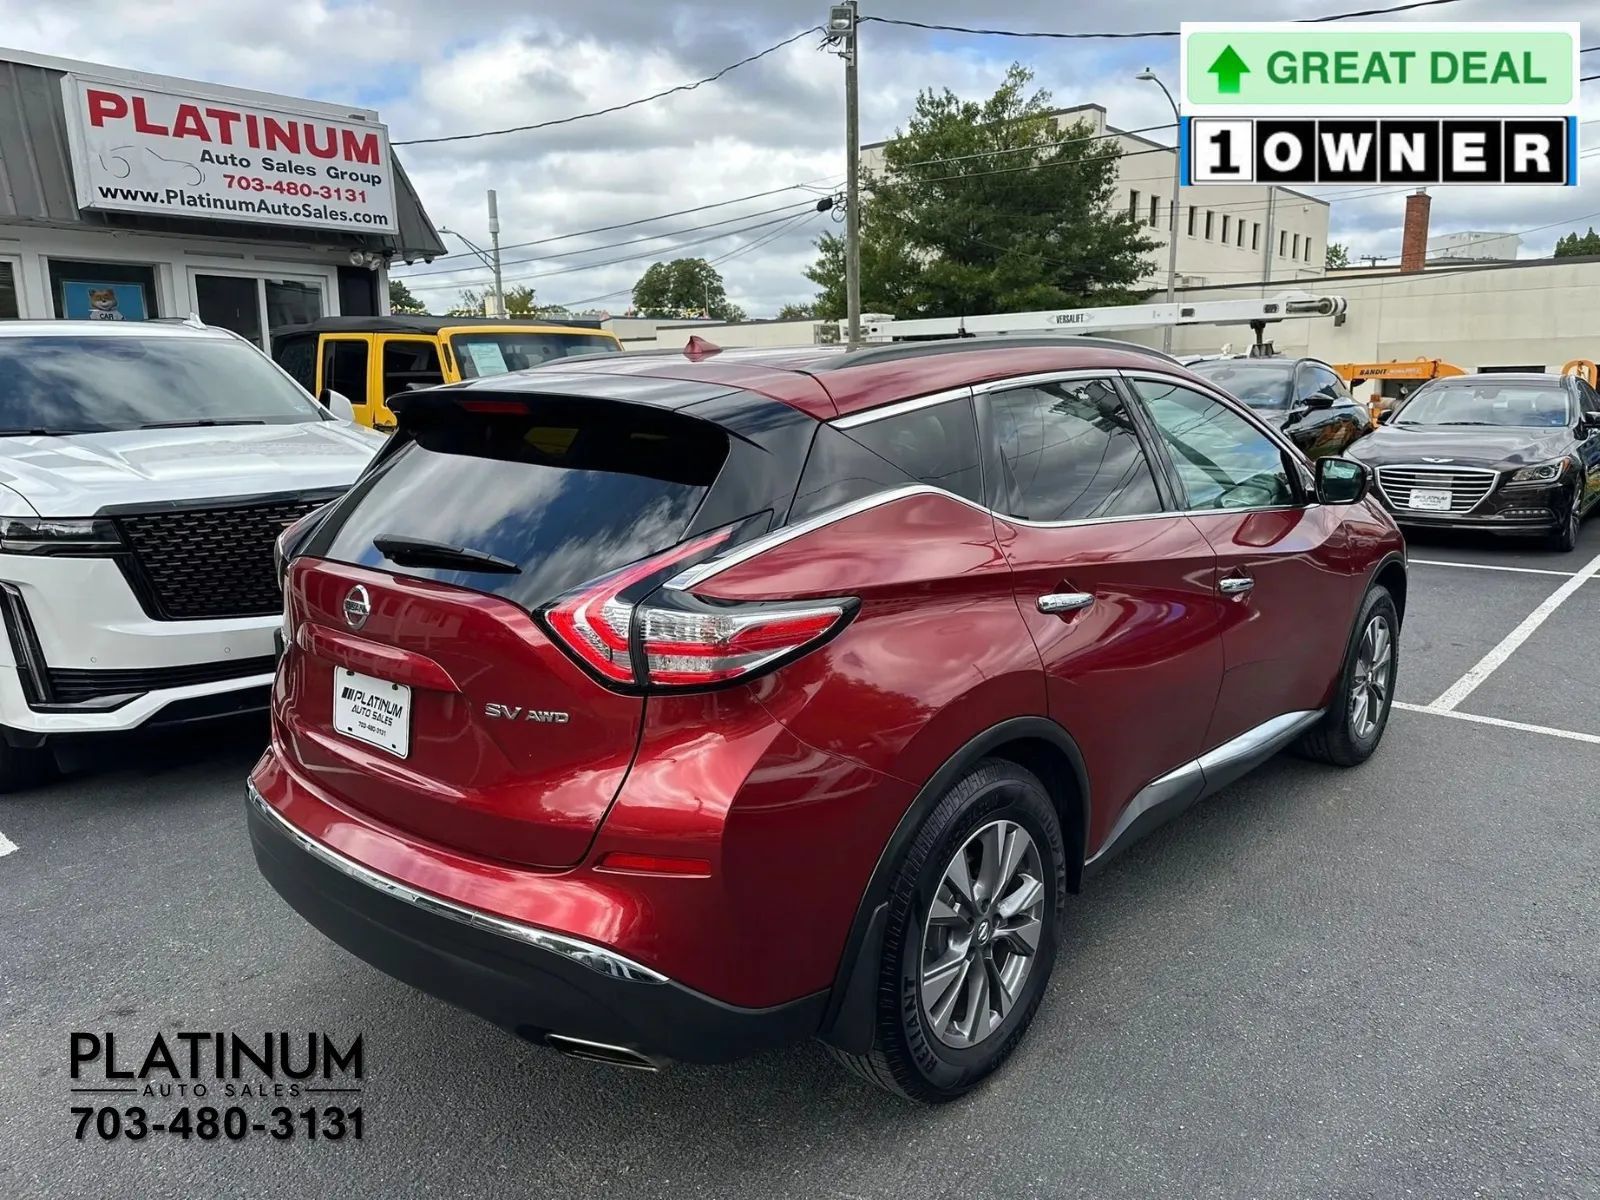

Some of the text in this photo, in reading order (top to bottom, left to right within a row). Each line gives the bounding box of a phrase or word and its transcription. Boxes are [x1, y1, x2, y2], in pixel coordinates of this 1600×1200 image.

[86, 89, 380, 166] PLATINUM
[200, 149, 382, 187] Auto Sales Group
[223, 173, 367, 203] 703-480-3131
[98, 186, 388, 225] www.PlatinumAutoSales.com
[1056, 314, 1084, 324] VERSALIFT
[351, 704, 393, 727] AUTO SALES
[353, 690, 403, 719] PLATINUM
[485, 703, 569, 723] SV AWD
